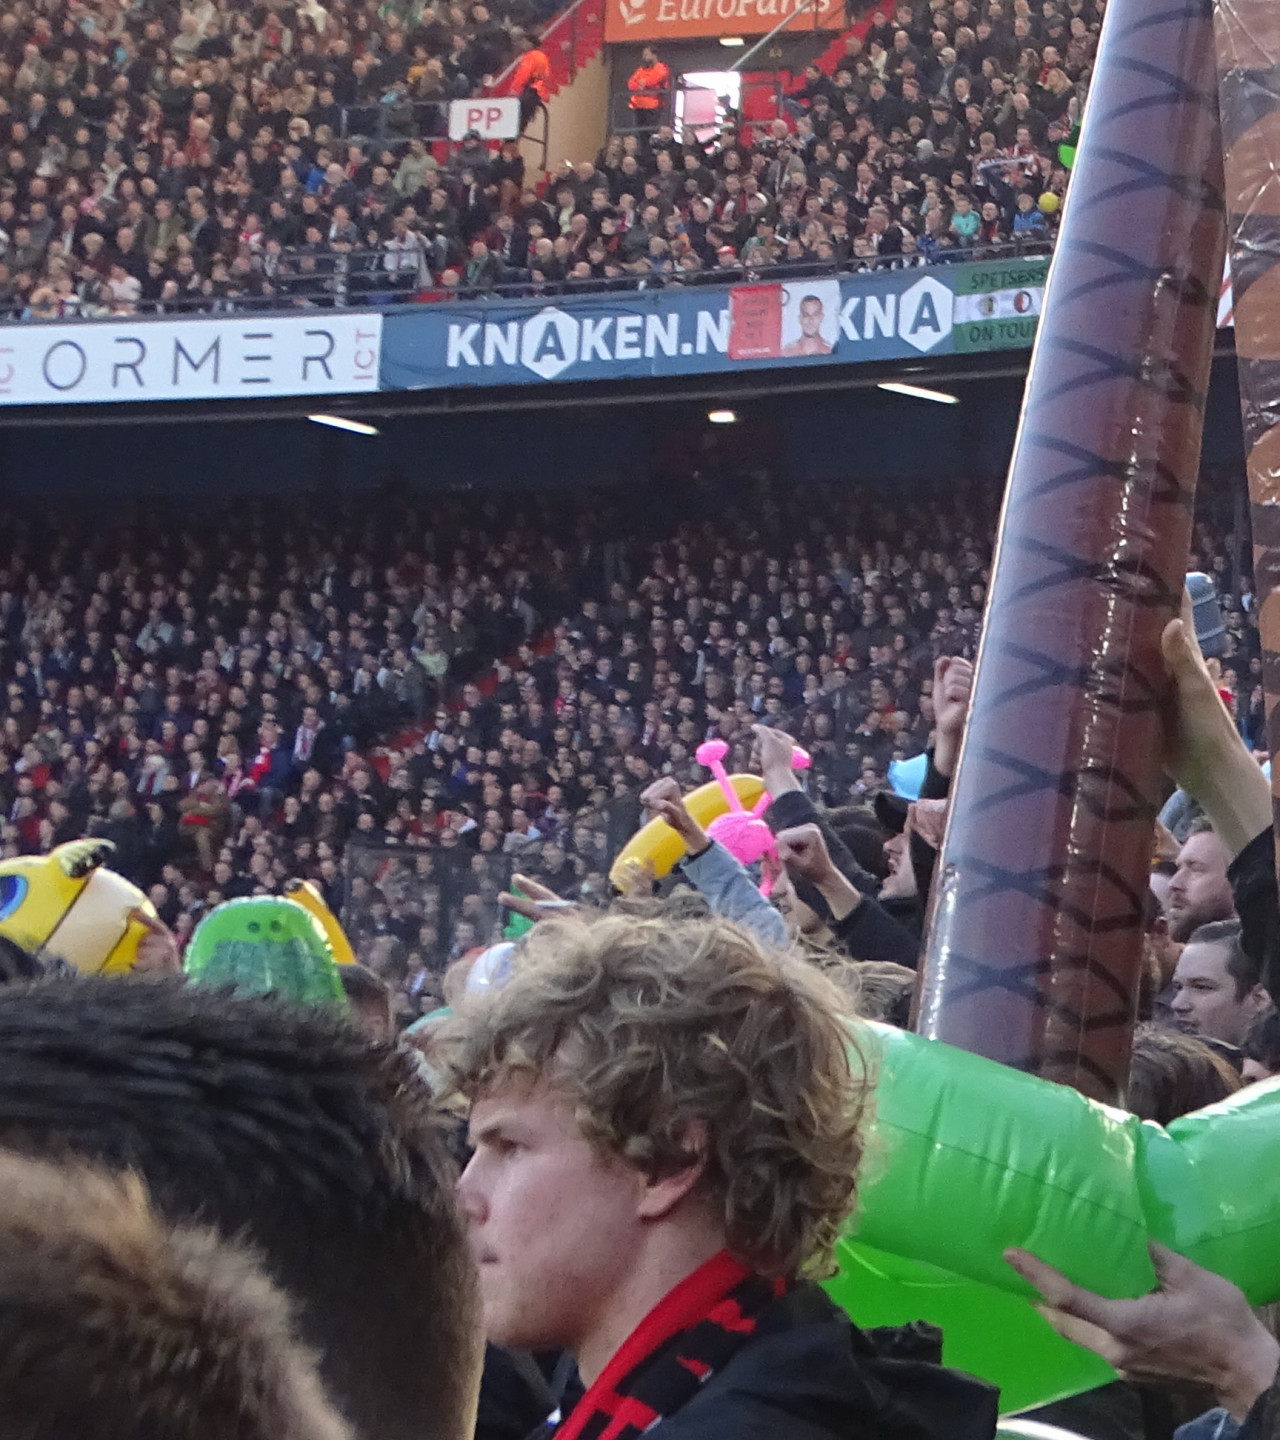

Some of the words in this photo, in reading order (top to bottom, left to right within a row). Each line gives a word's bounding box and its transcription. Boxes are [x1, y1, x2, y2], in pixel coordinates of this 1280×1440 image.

[467, 107, 503, 130] PP
[446, 309, 729, 368] KNAKEN.N
[839, 290, 942, 342] KNA
[998, 322, 1033, 339] TOU
[42, 329, 335, 391] ORMER
